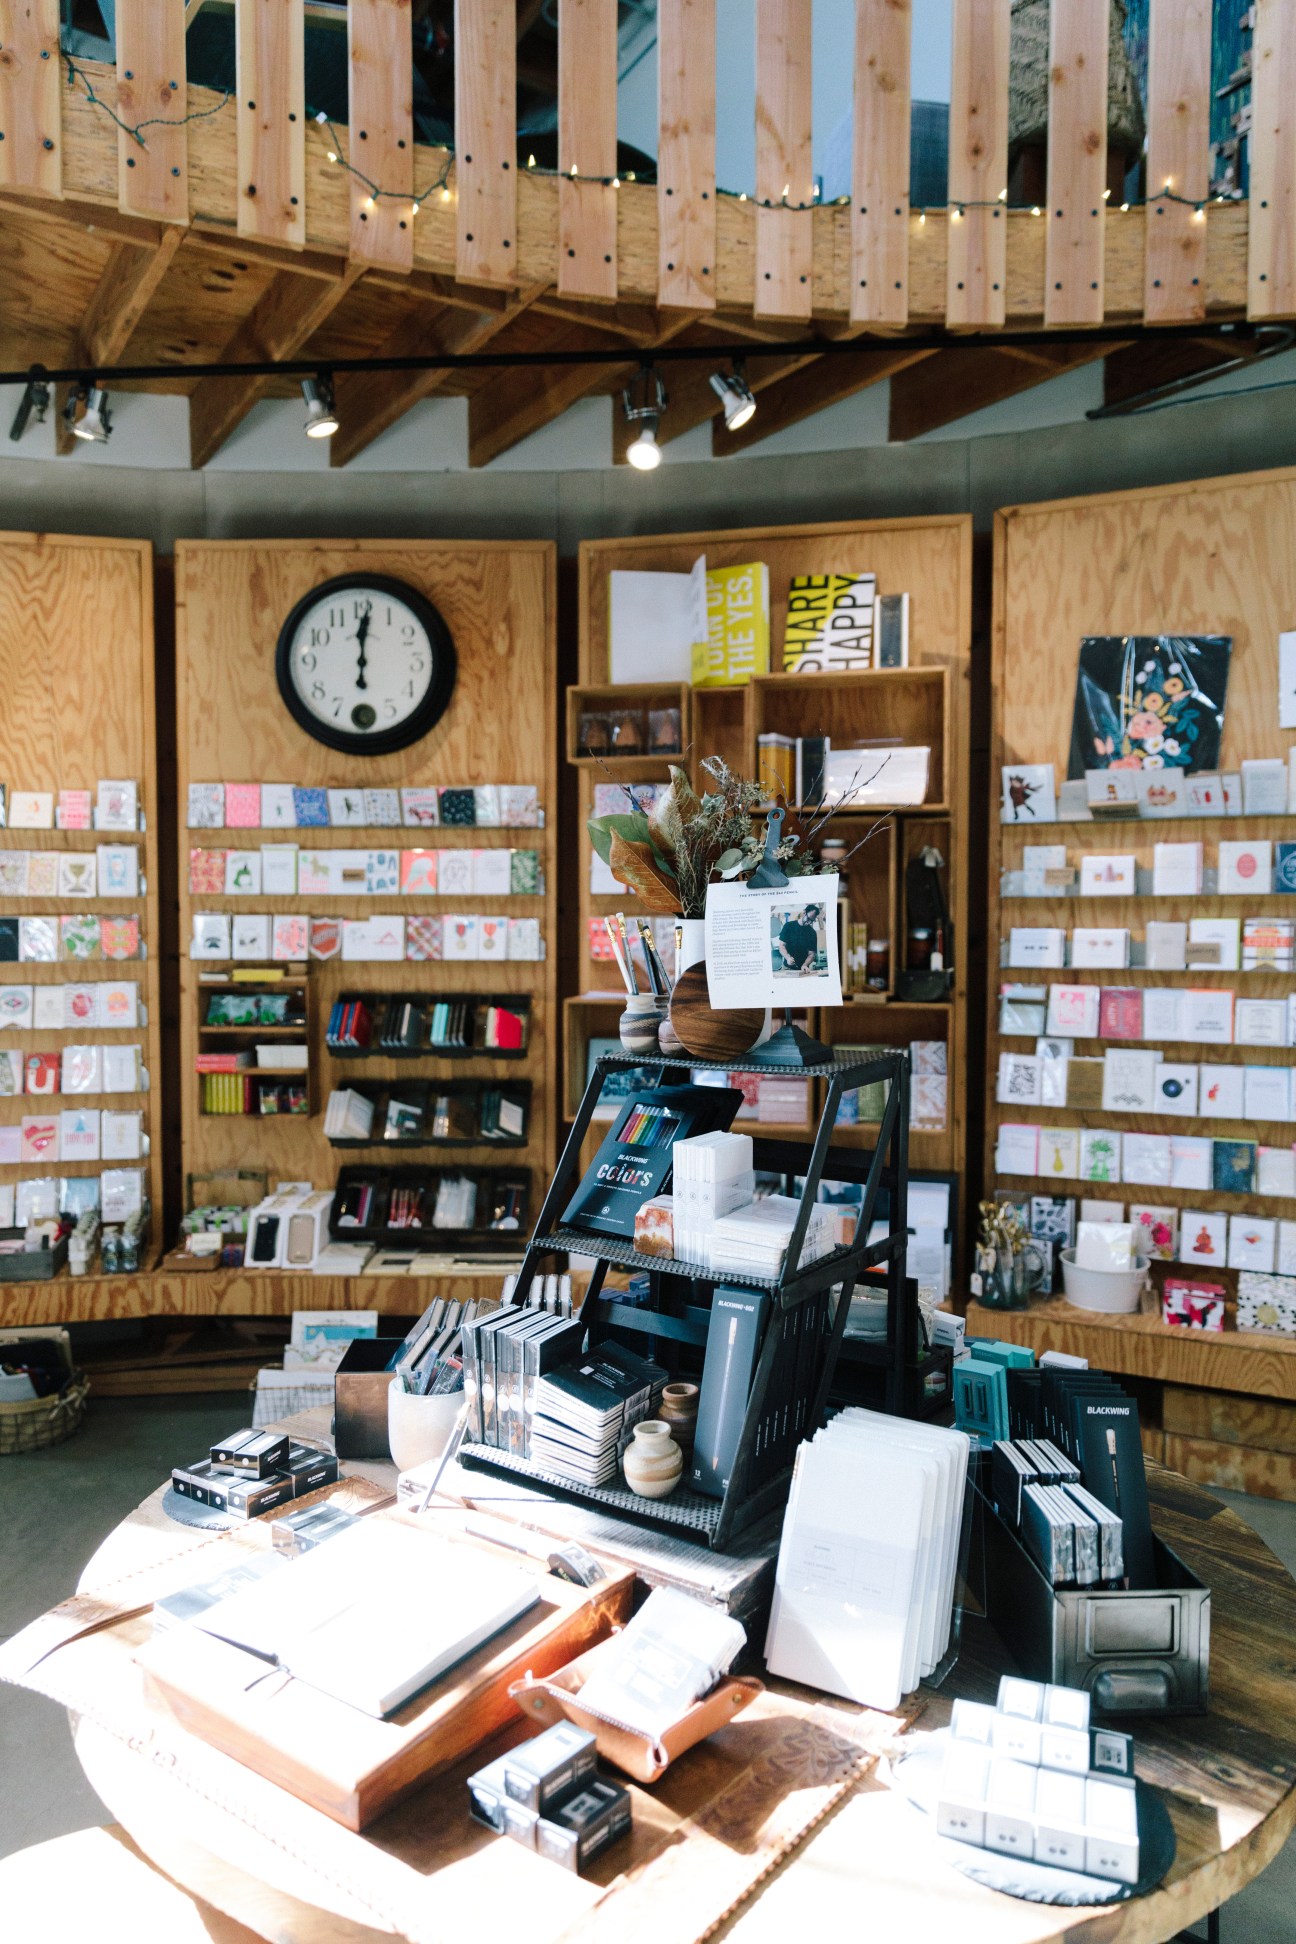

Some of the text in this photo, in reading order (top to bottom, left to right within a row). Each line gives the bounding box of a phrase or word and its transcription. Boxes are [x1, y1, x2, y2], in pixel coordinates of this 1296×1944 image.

[726, 567, 755, 679] THE YES.
[310, 627, 331, 647] 10
[401, 625, 415, 646] 2
[301, 653, 317, 673] 9
[409, 652, 424, 673] 3
[311, 680, 326, 700] 8
[401, 680, 414, 699] 4
[331, 696, 344, 717] 7
[383, 698, 397, 719] 5
[617, 1154, 648, 1164] BLACKWING
[1087, 1406, 1130, 1416] BLACKWING
[694, 1469, 701, 1477] 12
